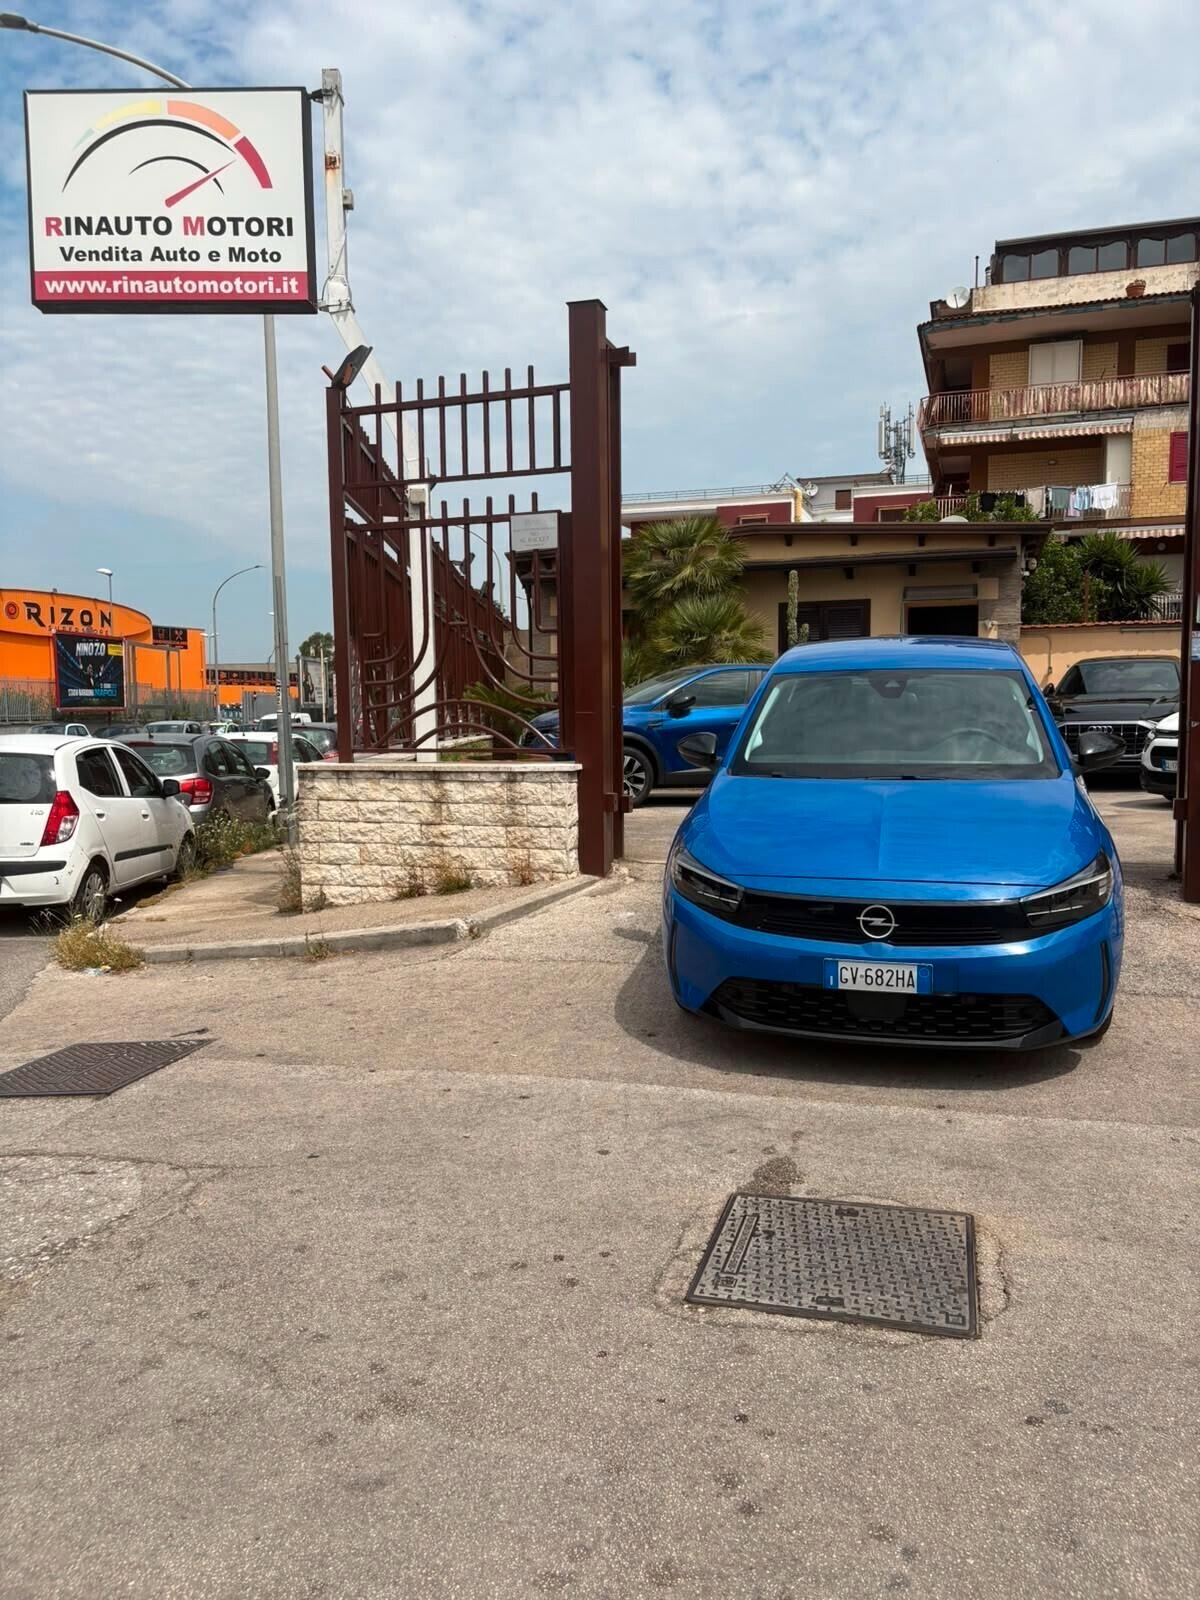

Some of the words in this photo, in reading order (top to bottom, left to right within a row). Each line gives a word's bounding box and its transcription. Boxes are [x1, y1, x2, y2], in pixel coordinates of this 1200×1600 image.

[45, 216, 172, 237] RINAUTO
[183, 216, 294, 237] MOTORI
[59, 246, 142, 262] Vendita
[150, 246, 200, 262] Auto
[208, 250, 220, 262] e
[228, 247, 282, 263] Moto
[45, 276, 298, 294] www.rinautomotori.it
